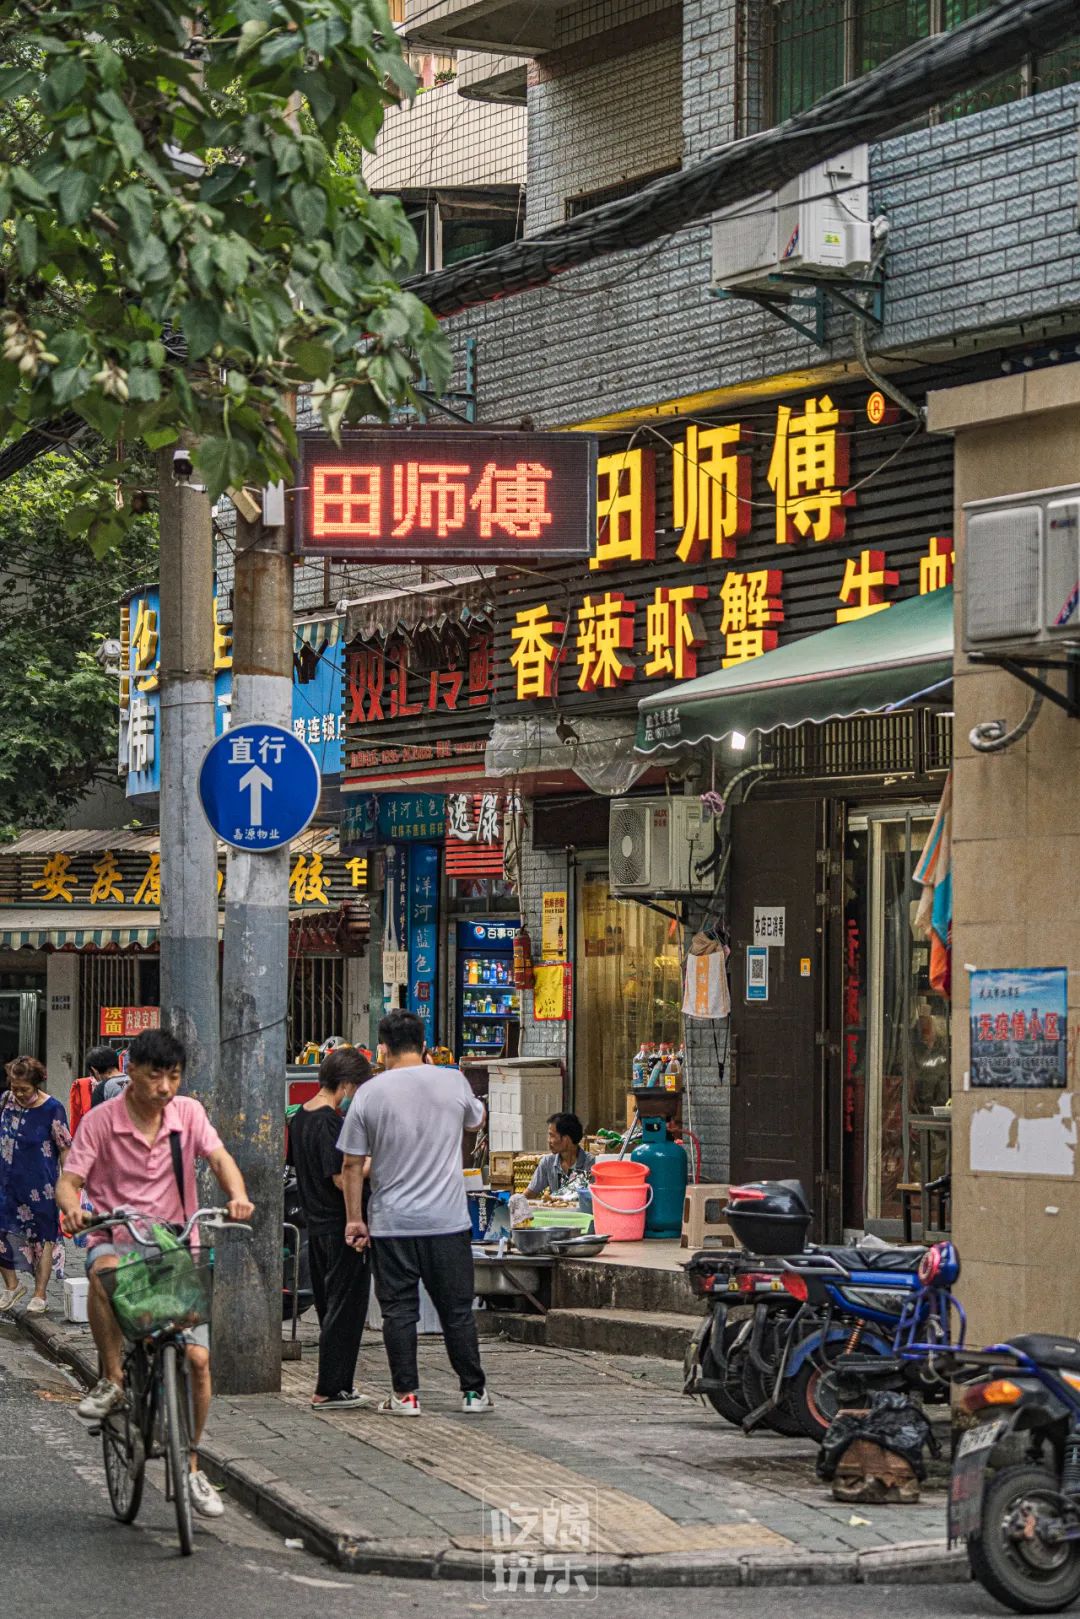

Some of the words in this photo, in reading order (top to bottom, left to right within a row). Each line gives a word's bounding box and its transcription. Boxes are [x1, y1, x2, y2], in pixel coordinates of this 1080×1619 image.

[590, 396, 844, 571] 田师傅
[311, 461, 554, 539] 田师傅
[510, 570, 770, 700] 香辣虾蟹
[228, 735, 287, 765] 直行
[233, 827, 281, 841] 嘉源物业
[487, 927, 521, 939] 百事可
[755, 916, 784, 937] 本店已消毒
[104, 1007, 124, 1034] 凉面
[978, 1010, 1060, 1041] 无疫情小区
